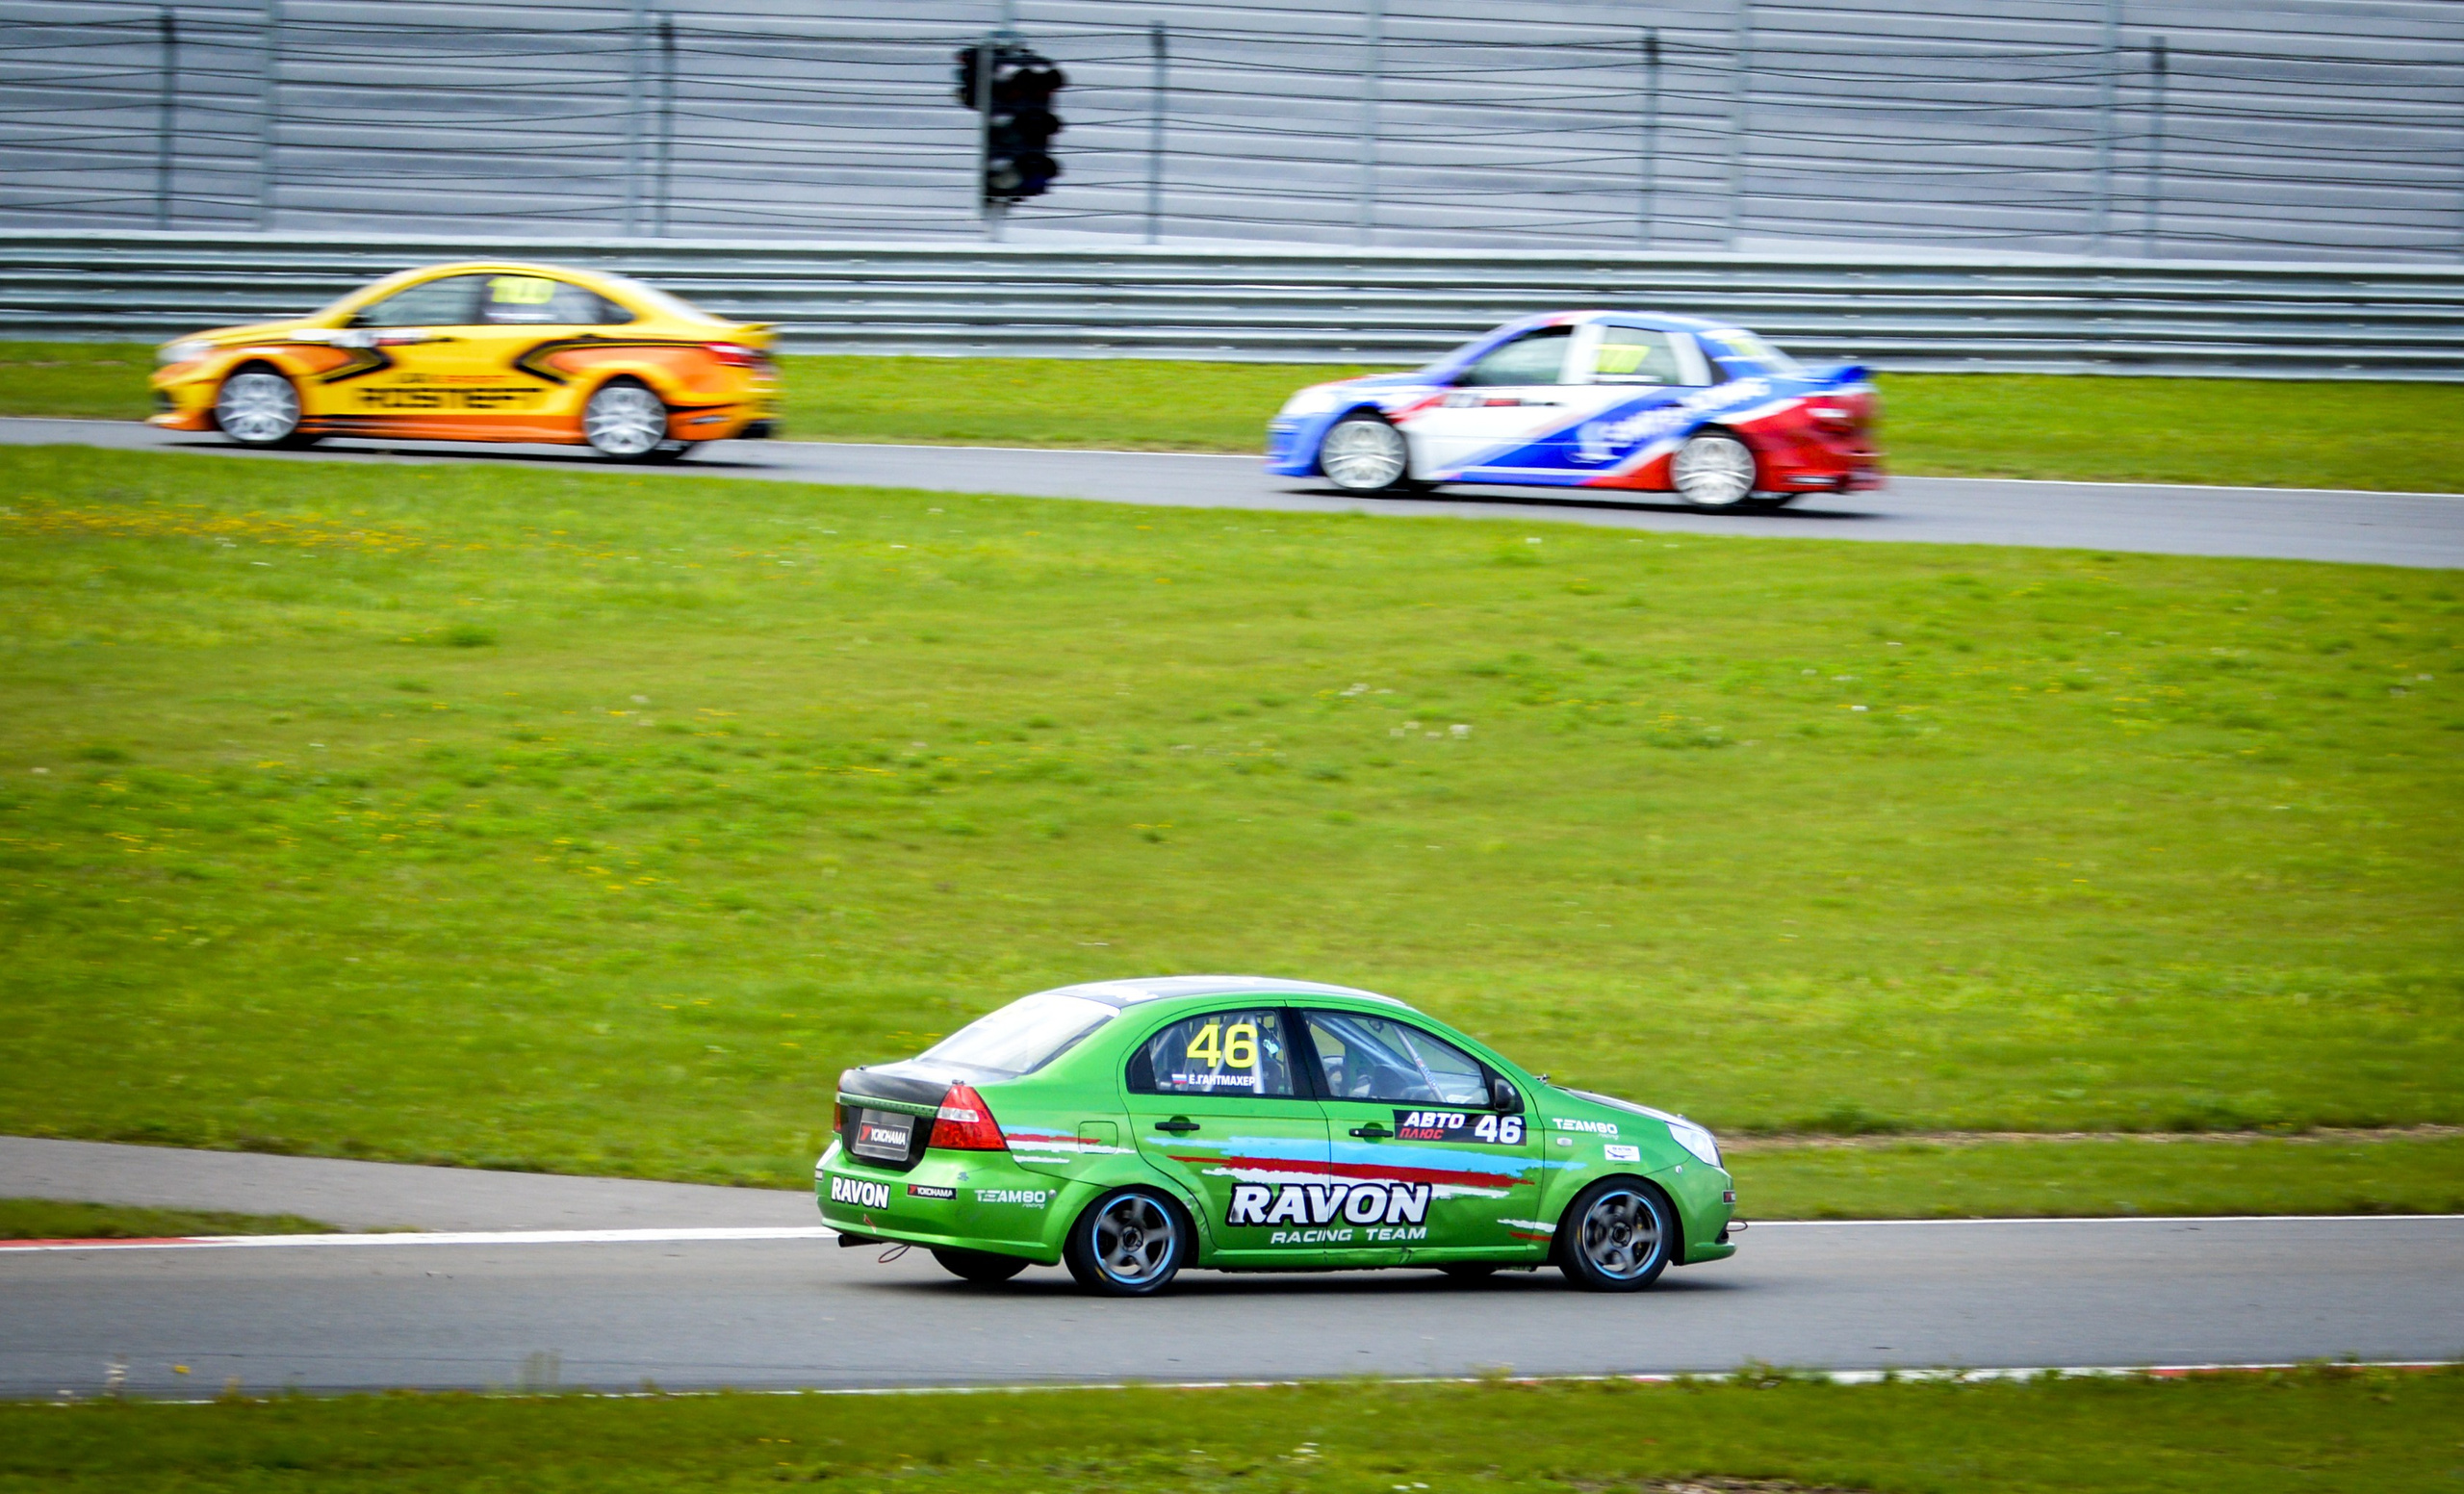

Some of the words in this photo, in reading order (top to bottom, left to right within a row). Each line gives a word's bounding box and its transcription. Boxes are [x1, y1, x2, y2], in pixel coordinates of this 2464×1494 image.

[1187, 1023, 1257, 1068] 46
[1189, 1073, 1255, 1086] Е.ГАНТМАХЕР
[1403, 1112, 1465, 1128] АВТО
[1553, 1118, 1618, 1134] TEAM80
[871, 1127, 906, 1146] YOKOHAMA
[1399, 1128, 1444, 1140] ПЛЮС
[1475, 1115, 1522, 1144] 46
[831, 1176, 889, 1209] RAVON
[916, 1186, 954, 1198] YOKOHAMA
[974, 1189, 1046, 1202] TEAM80
[1227, 1184, 1432, 1224] RAVON
[1270, 1228, 1353, 1244] RACING
[1366, 1226, 1427, 1241] TEAM
